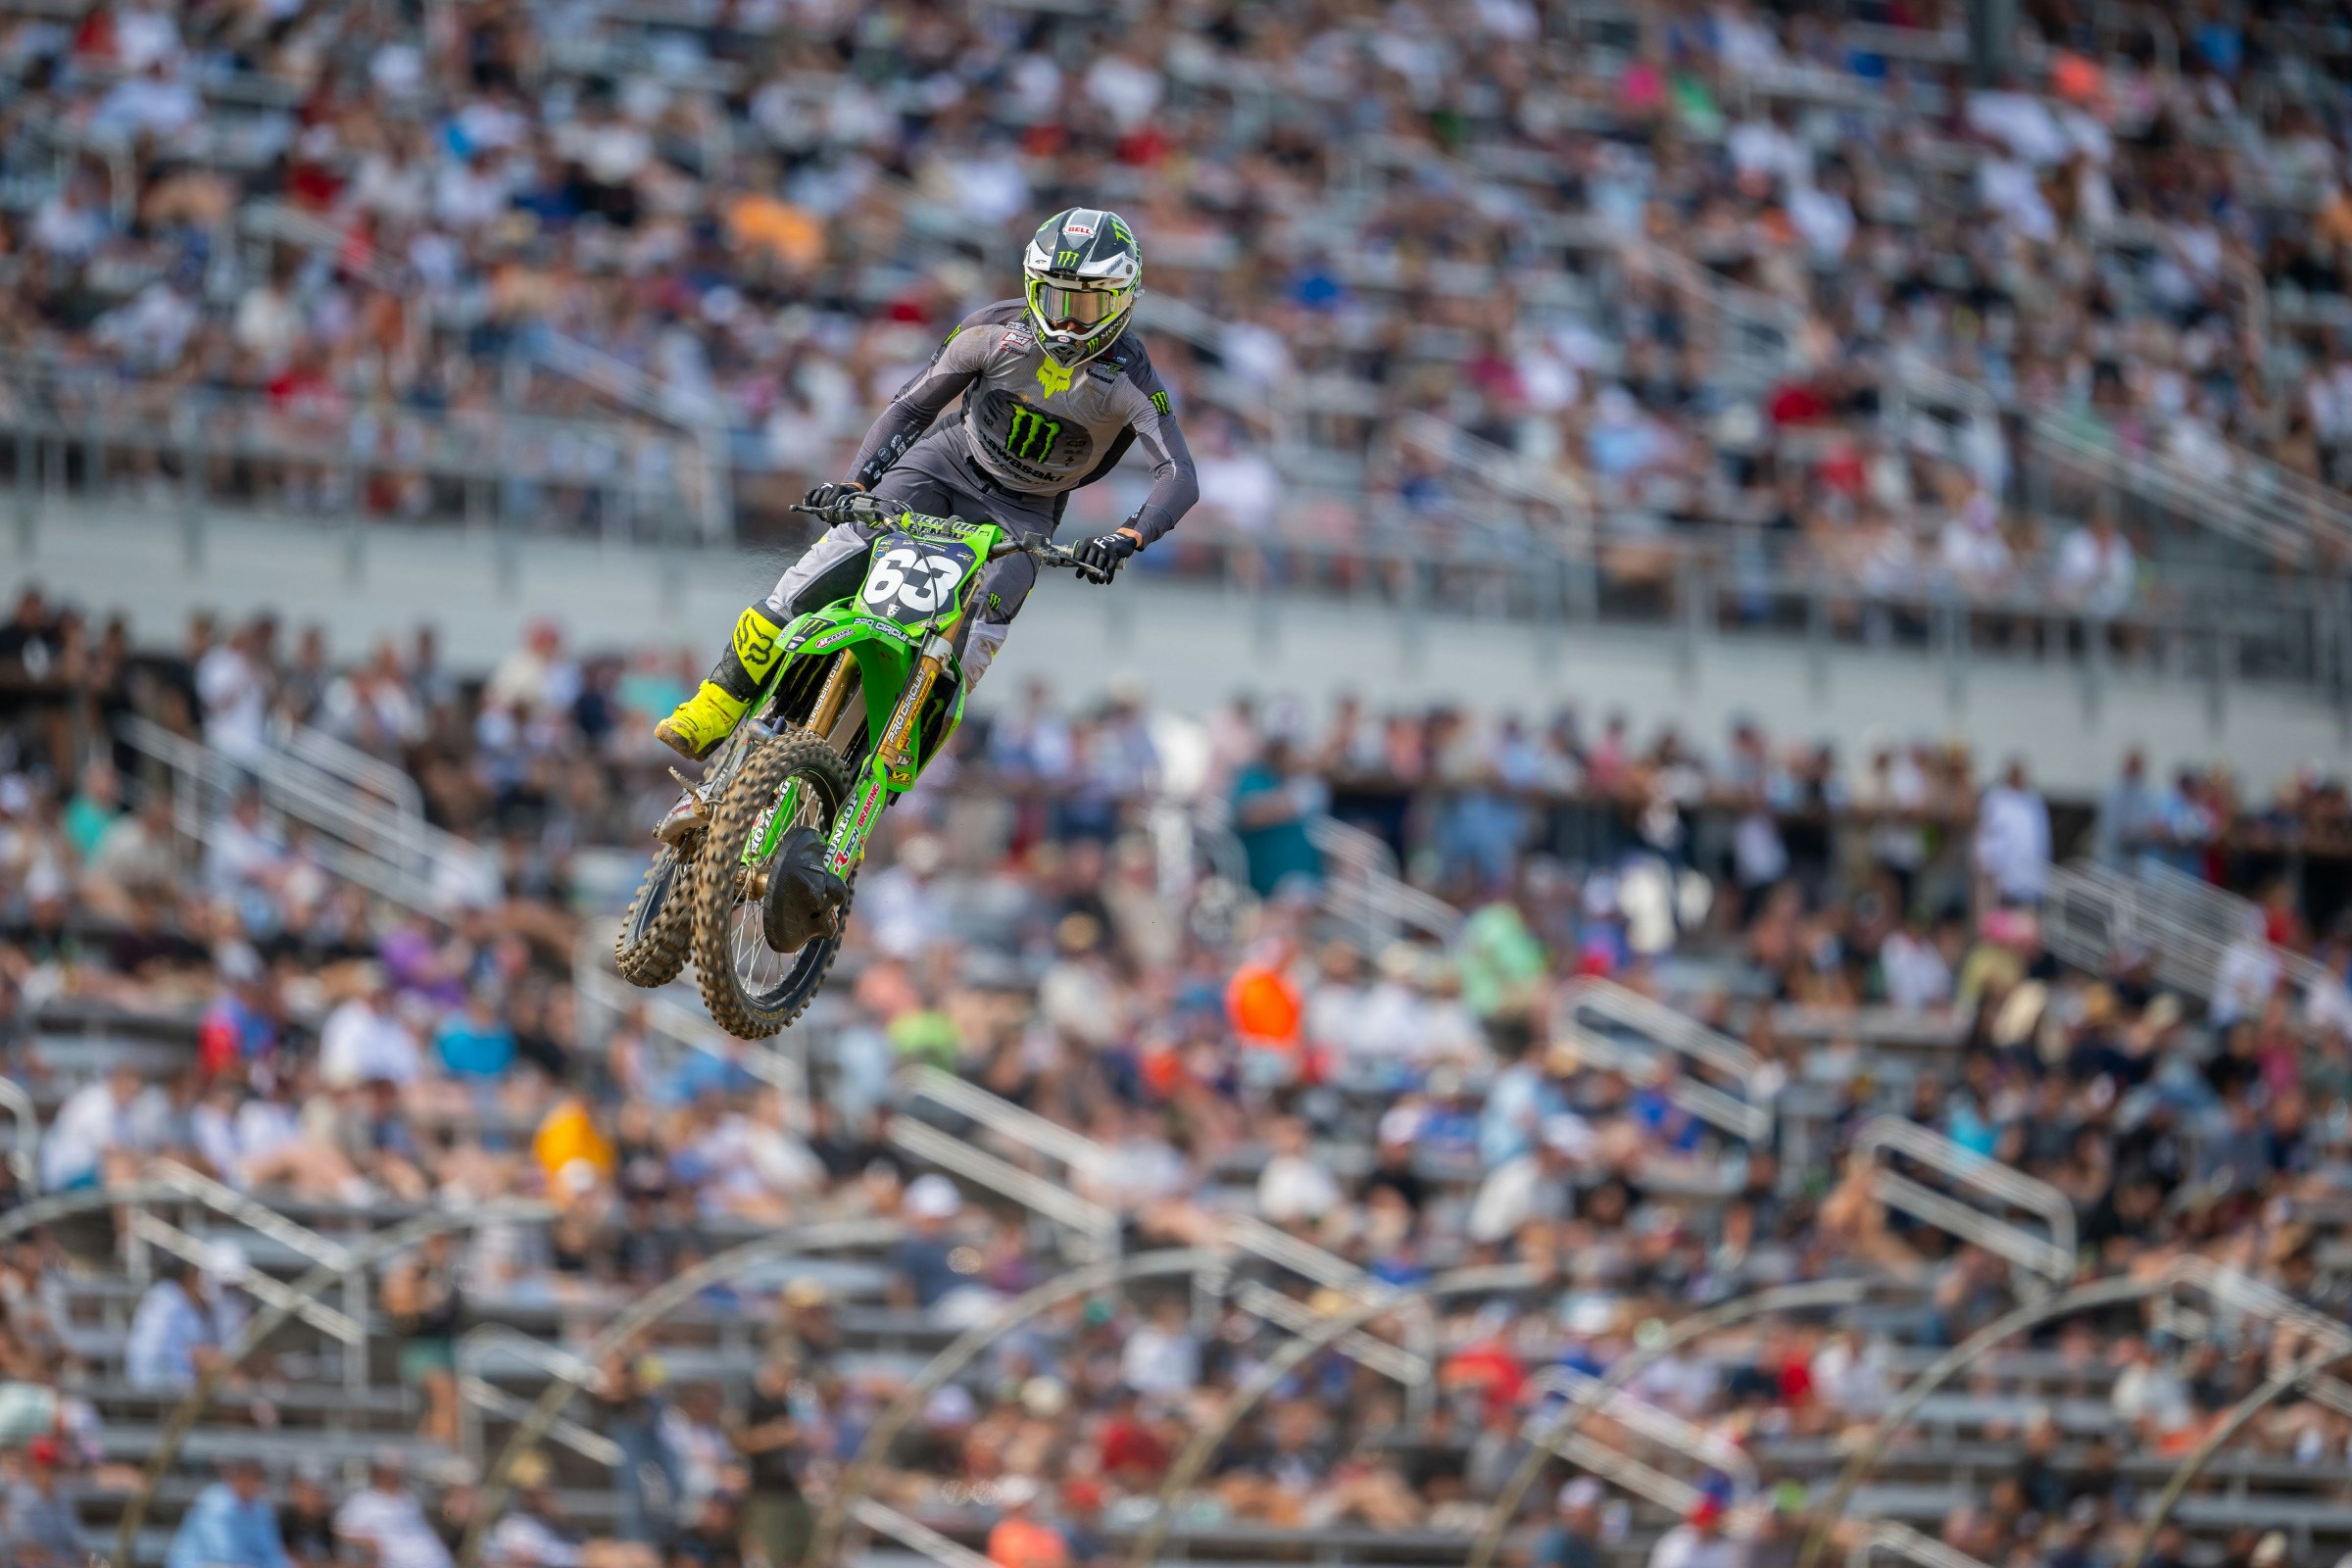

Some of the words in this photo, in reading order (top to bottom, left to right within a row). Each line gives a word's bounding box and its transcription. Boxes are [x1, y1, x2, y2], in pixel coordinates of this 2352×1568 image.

[862, 548, 962, 612] 63
[854, 618, 874, 627] PRO
[874, 625, 908, 642] CIRCUI
[887, 714, 905, 744] PRO
[900, 666, 926, 717] CIRCUIT
[823, 792, 859, 868] DUNLOP
[856, 782, 880, 828] BRAKING
